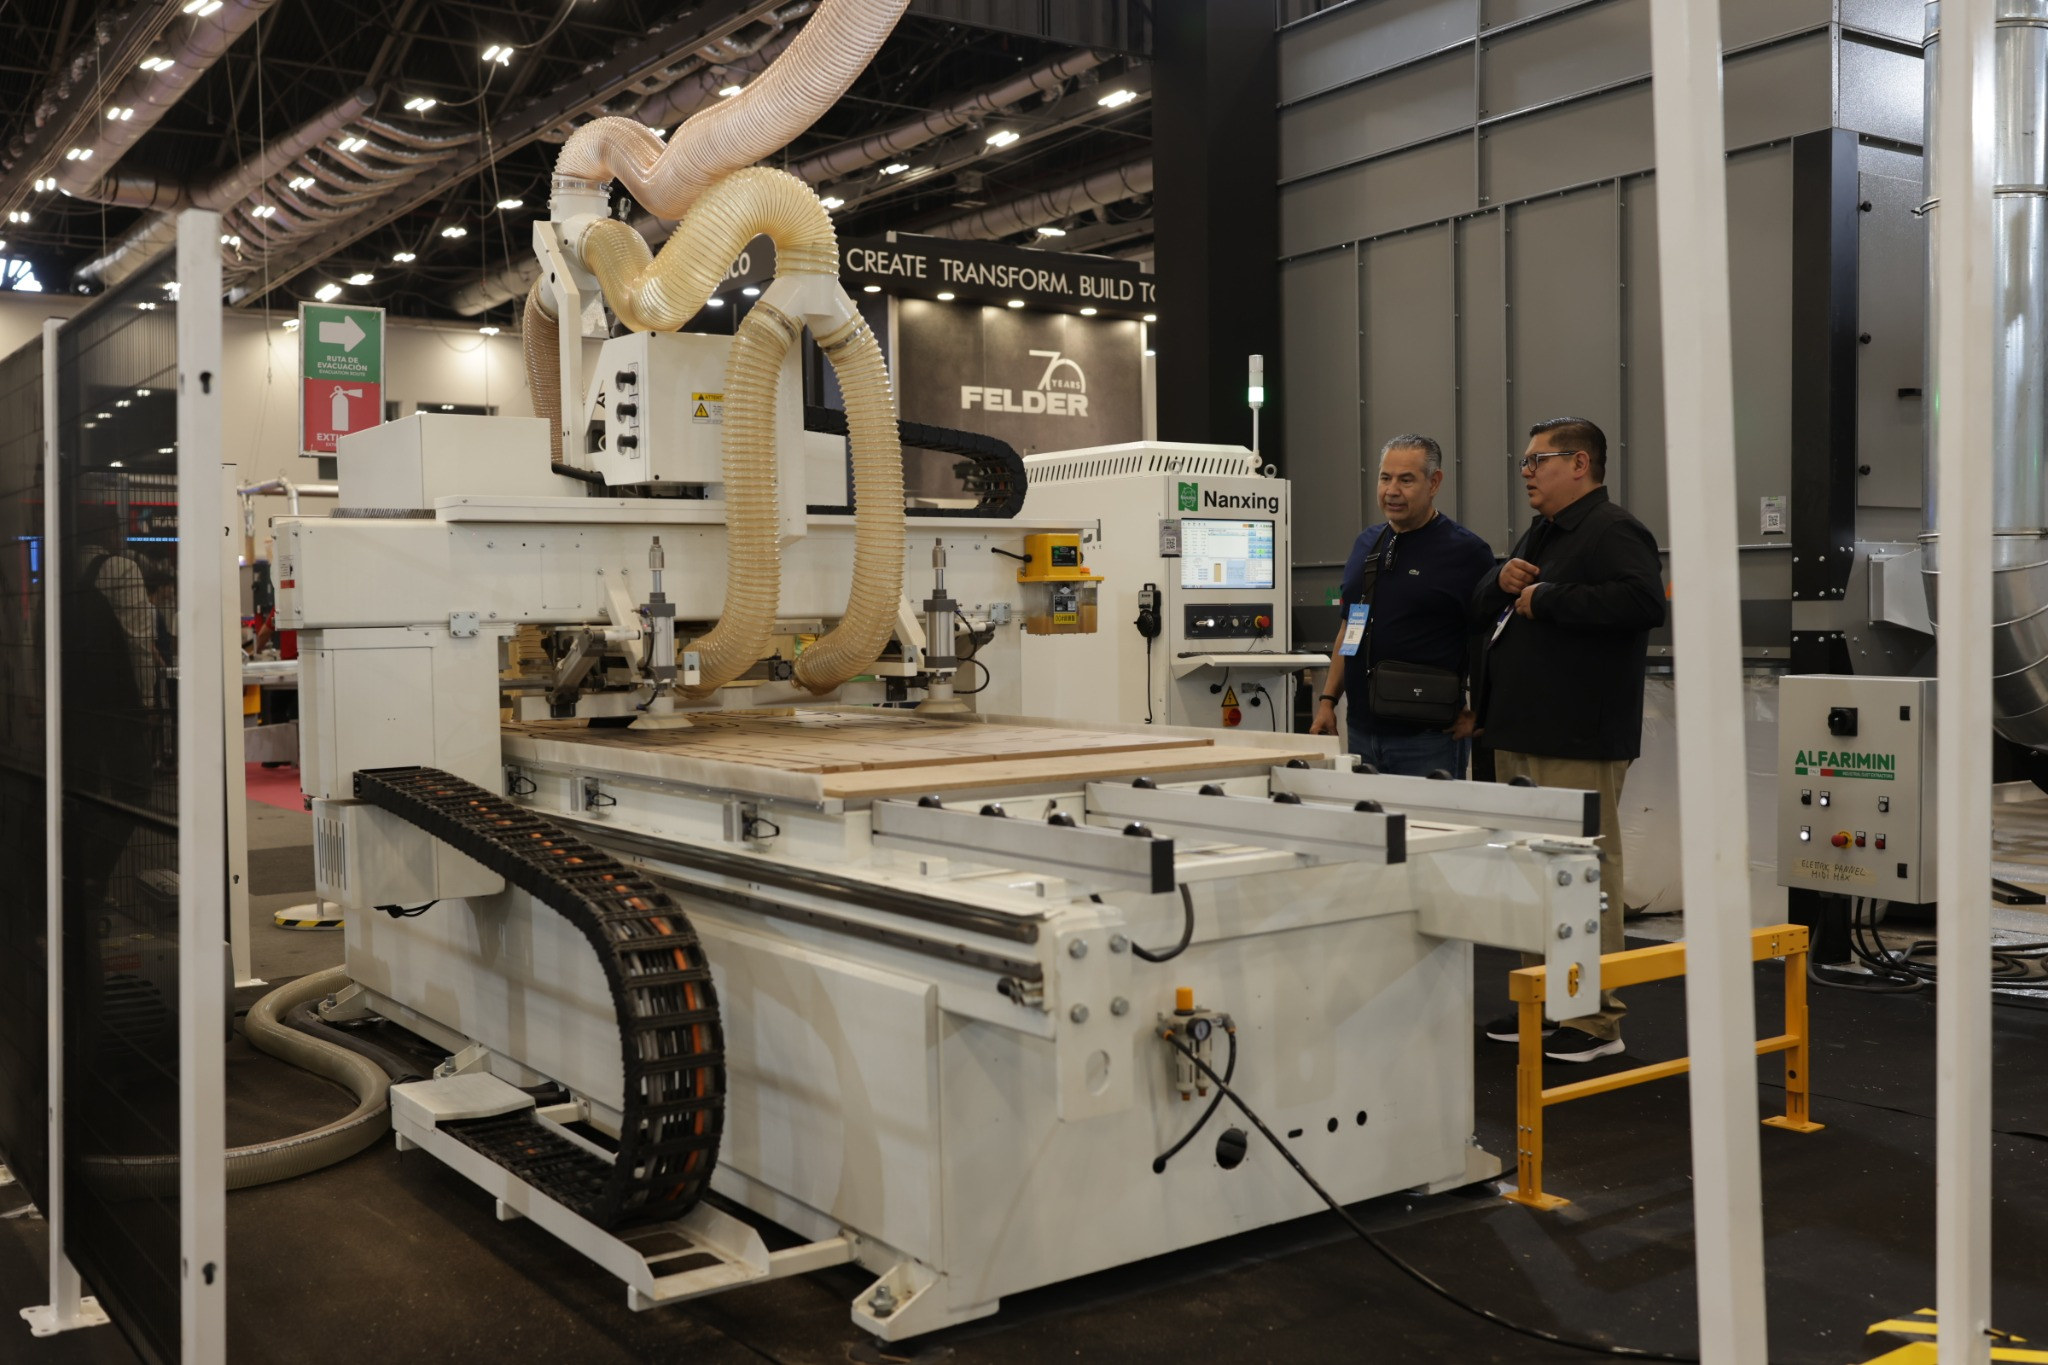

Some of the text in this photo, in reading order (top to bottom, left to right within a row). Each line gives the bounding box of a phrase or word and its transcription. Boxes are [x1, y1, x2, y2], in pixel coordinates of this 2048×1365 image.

[846, 247, 927, 279] CREATE
[939, 258, 1074, 295] TRANSFORM.
[1079, 275, 1134, 301] BUILD
[317, 361, 368, 372] EVACUACIÓN
[326, 355, 346, 363] RUTA
[1051, 379, 1081, 390] YEARS
[960, 385, 1089, 417] FELDER
[316, 432, 342, 442] EXTI
[1203, 490, 1279, 514] Nanxing
[1795, 750, 1895, 771] ALFARIMINI
